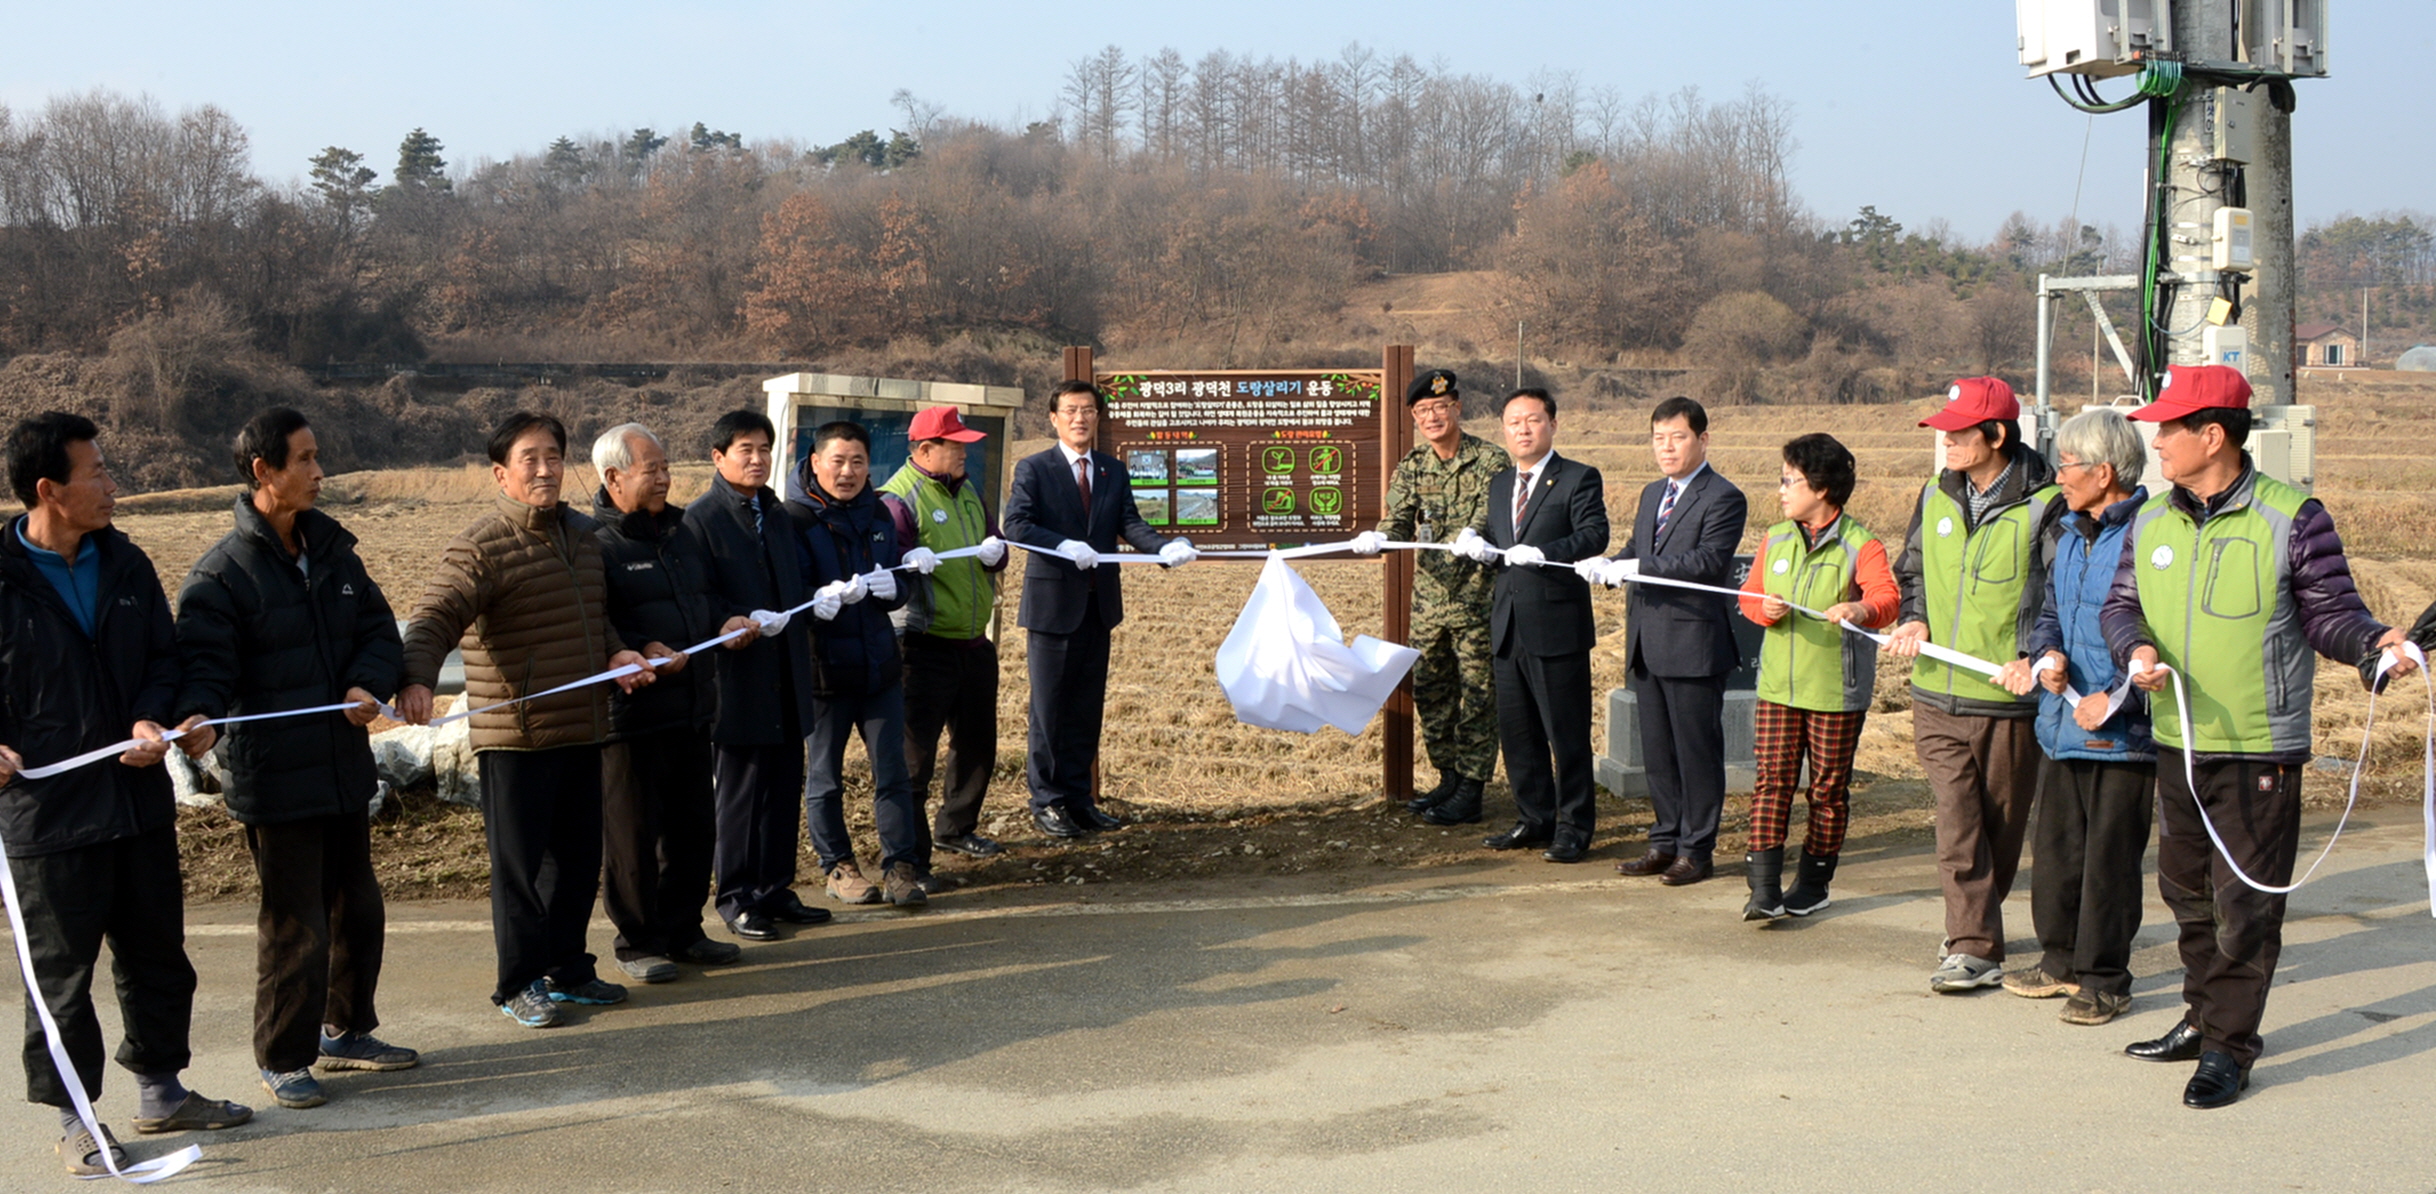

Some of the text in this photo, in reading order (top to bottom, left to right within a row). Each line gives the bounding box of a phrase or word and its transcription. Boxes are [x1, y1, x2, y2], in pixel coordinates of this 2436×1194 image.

[2223, 351, 2240, 362] KT
[1139, 381, 1333, 398] 광덕3리 광덕천 도랑살리기 운동
[1281, 430, 1295, 440] 도랑
